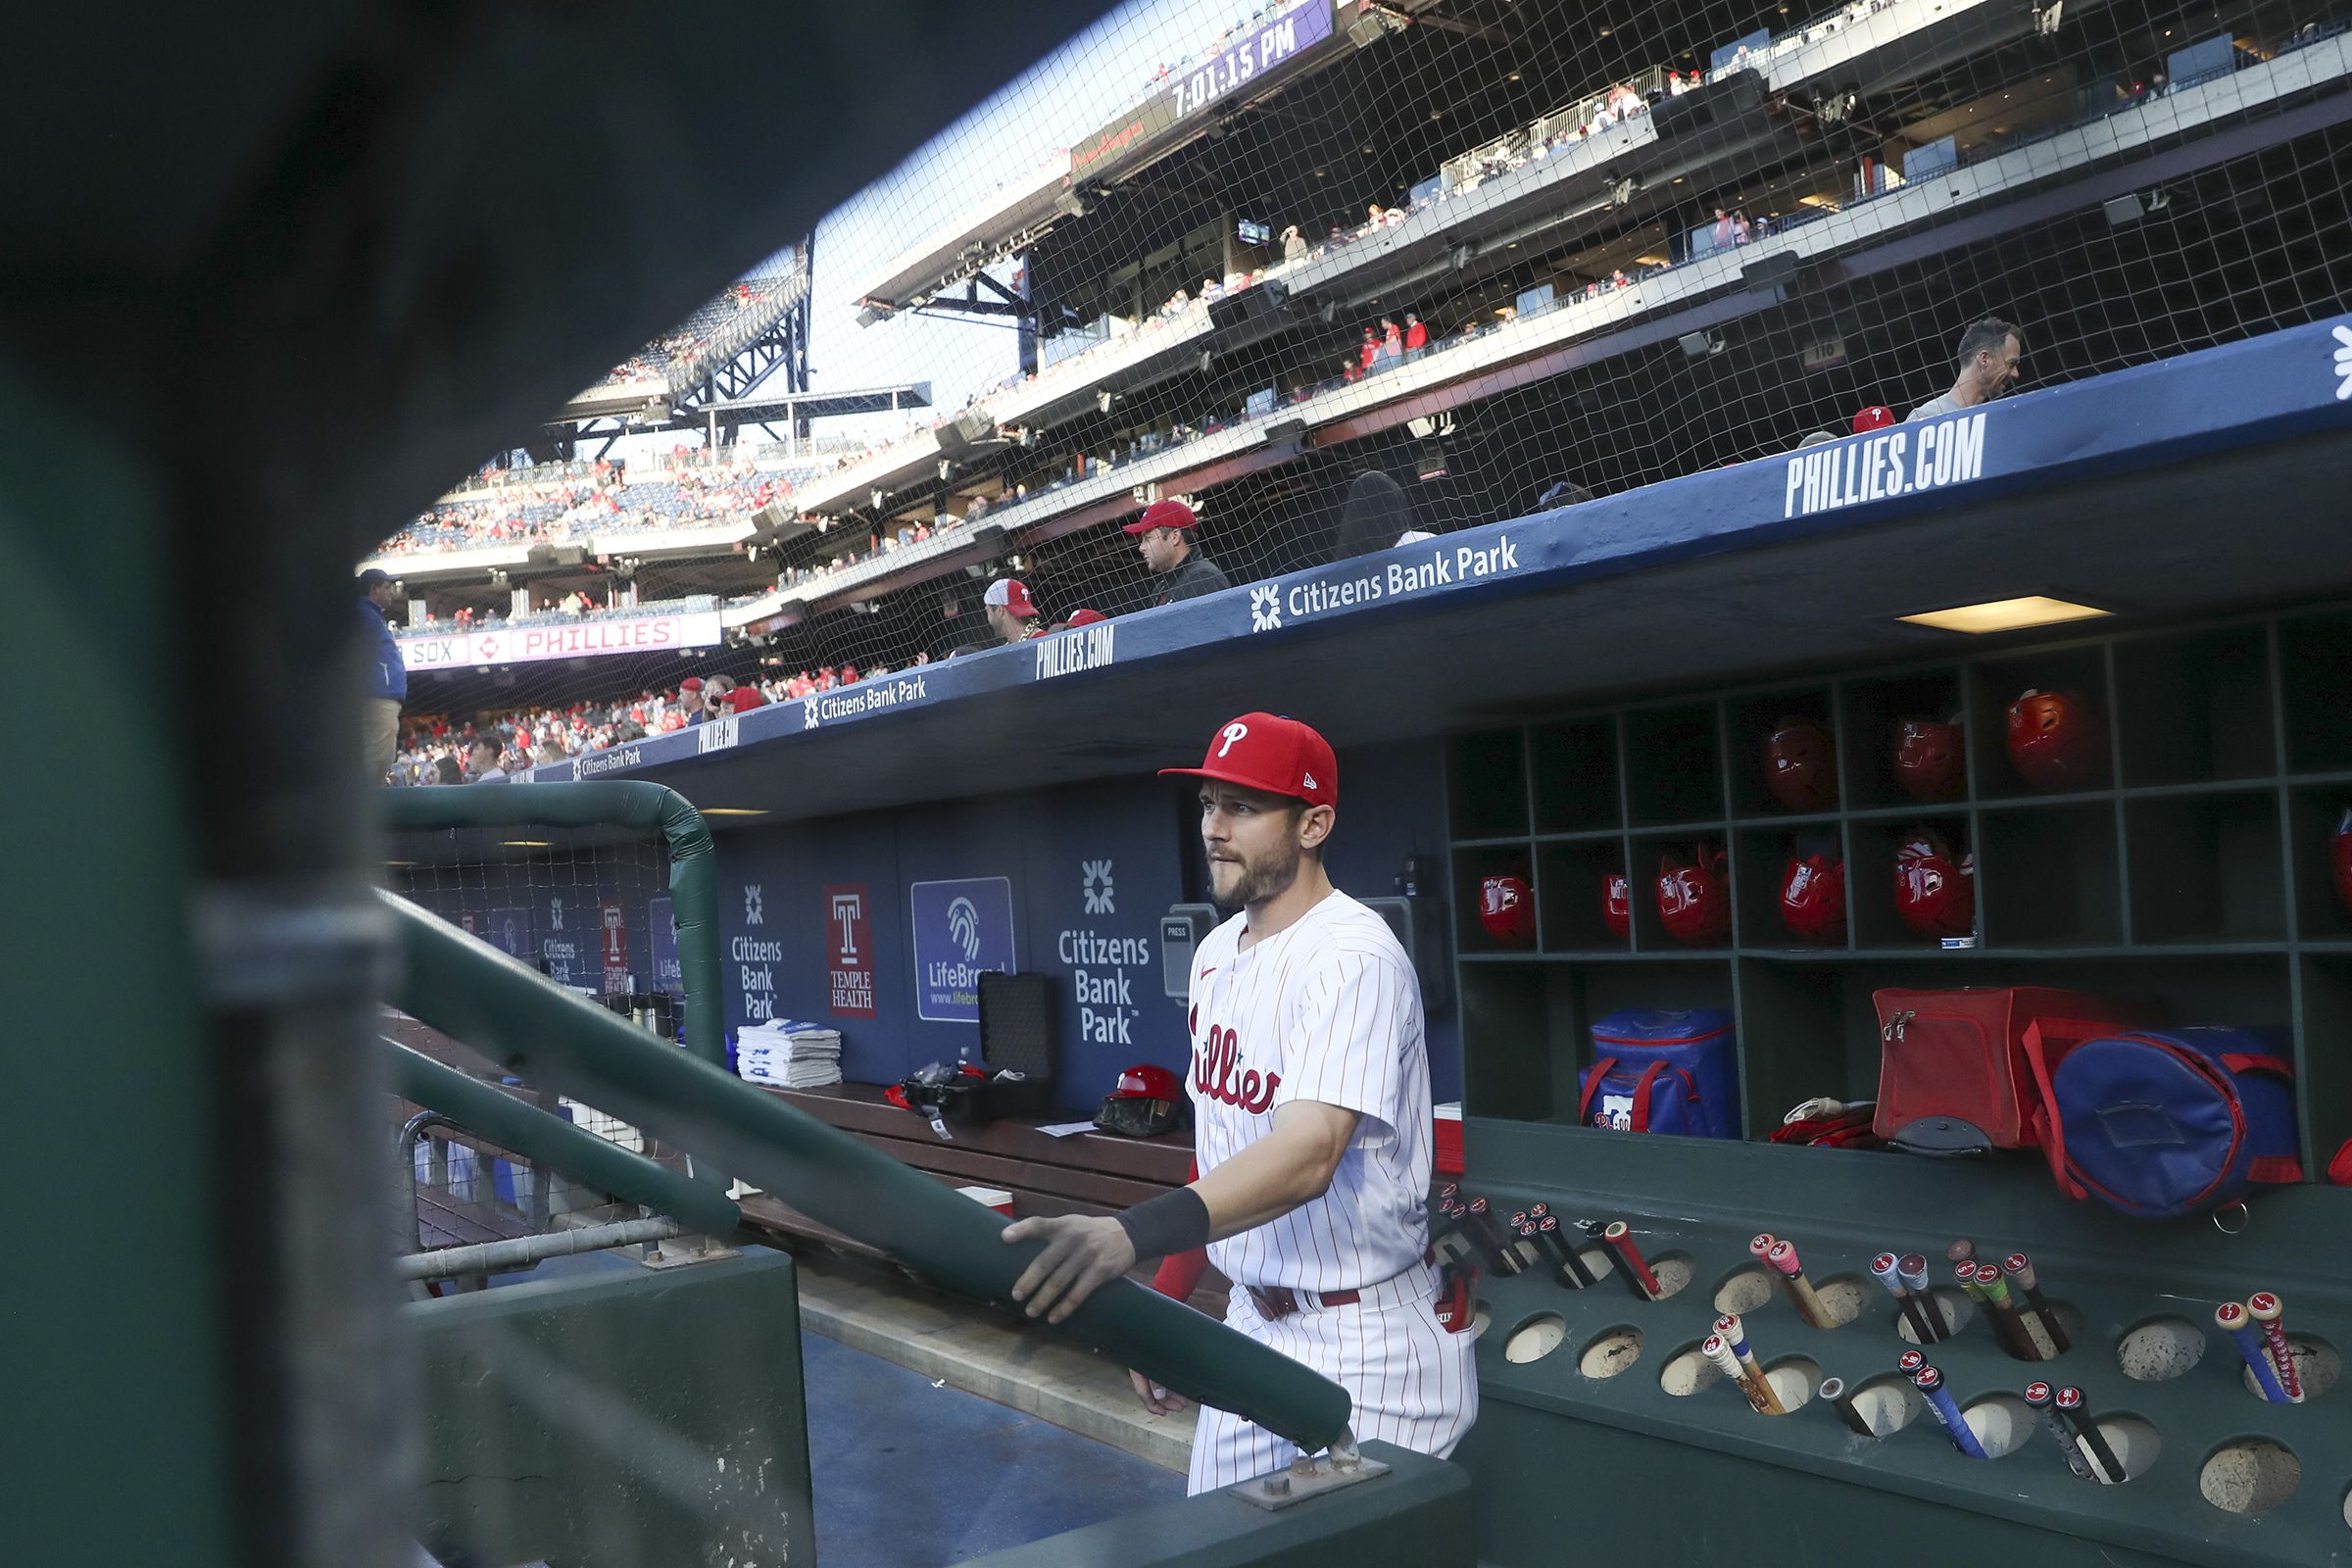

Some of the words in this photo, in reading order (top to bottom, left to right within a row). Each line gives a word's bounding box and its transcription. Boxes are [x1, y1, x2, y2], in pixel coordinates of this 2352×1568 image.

[1172, 44, 1253, 118] 7:01:15
[1260, 17, 1296, 68] PM
[1784, 413, 1986, 518] PHILLIES.COM
[1288, 575, 1383, 617] Citizens
[1388, 552, 1452, 595] Bank
[1456, 535, 1519, 580] Park
[413, 640, 453, 664] SOX
[525, 621, 670, 655] PHILLIES
[1035, 624, 1114, 680] PHILLIES.COM
[820, 692, 866, 719] Citizens
[866, 683, 896, 710] Bank
[898, 675, 926, 703] Park
[1217, 722, 1248, 758] P
[582, 758, 608, 775] Citizens
[608, 750, 625, 769] Bank
[624, 746, 641, 765] Park
[731, 936, 782, 963] Citizens
[1058, 930, 1150, 966] Citizens
[1167, 926, 1187, 938] PRESS
[741, 964, 773, 992] Bank
[830, 970, 871, 990] TEMPLE
[1075, 968, 1132, 1006] Bank
[831, 989, 872, 1009] HEALTH
